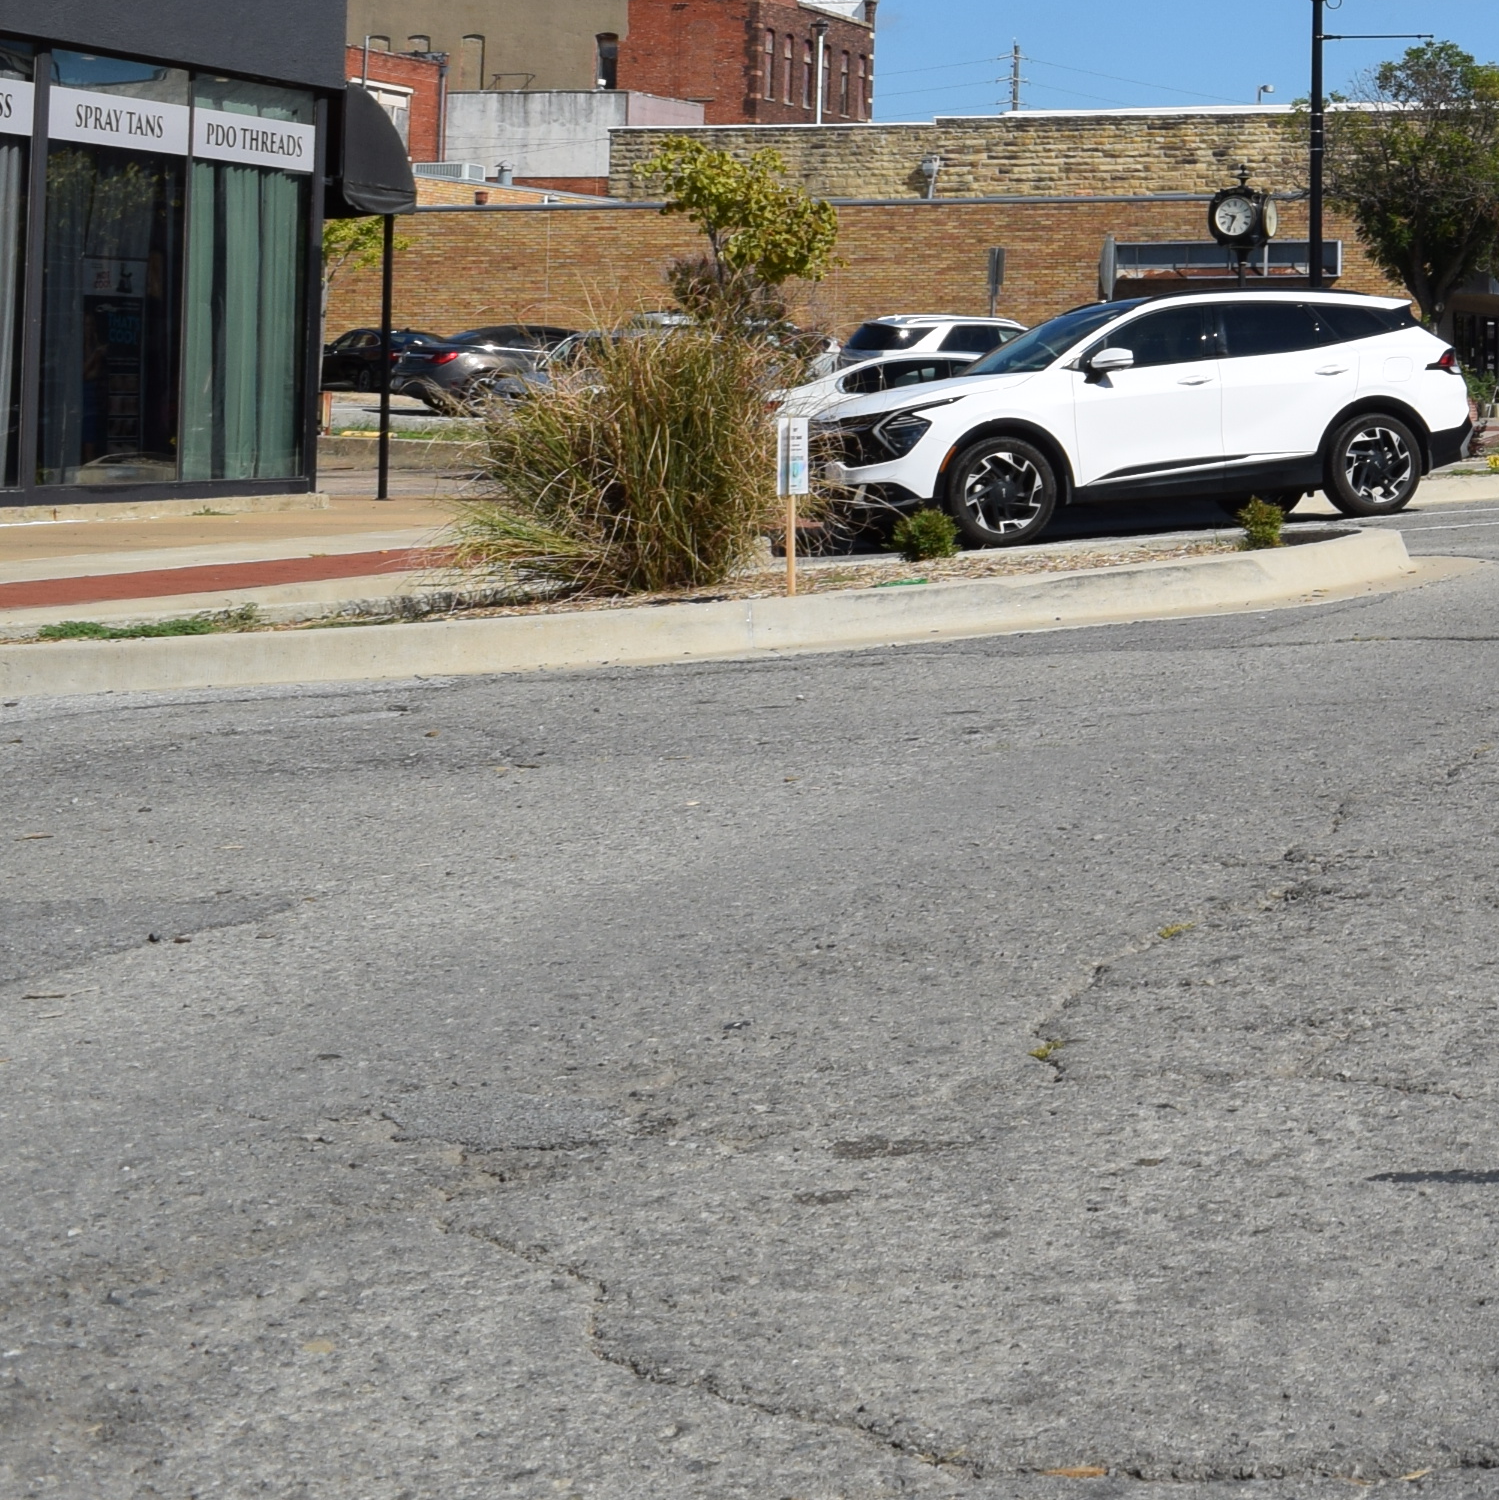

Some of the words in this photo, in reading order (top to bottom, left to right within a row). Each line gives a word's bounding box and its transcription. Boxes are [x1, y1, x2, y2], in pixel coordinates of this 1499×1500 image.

[75, 104, 123, 132] SPRAY
[126, 111, 164, 139] TANS
[206, 122, 237, 148] PDO
[240, 128, 303, 157] THREADS
